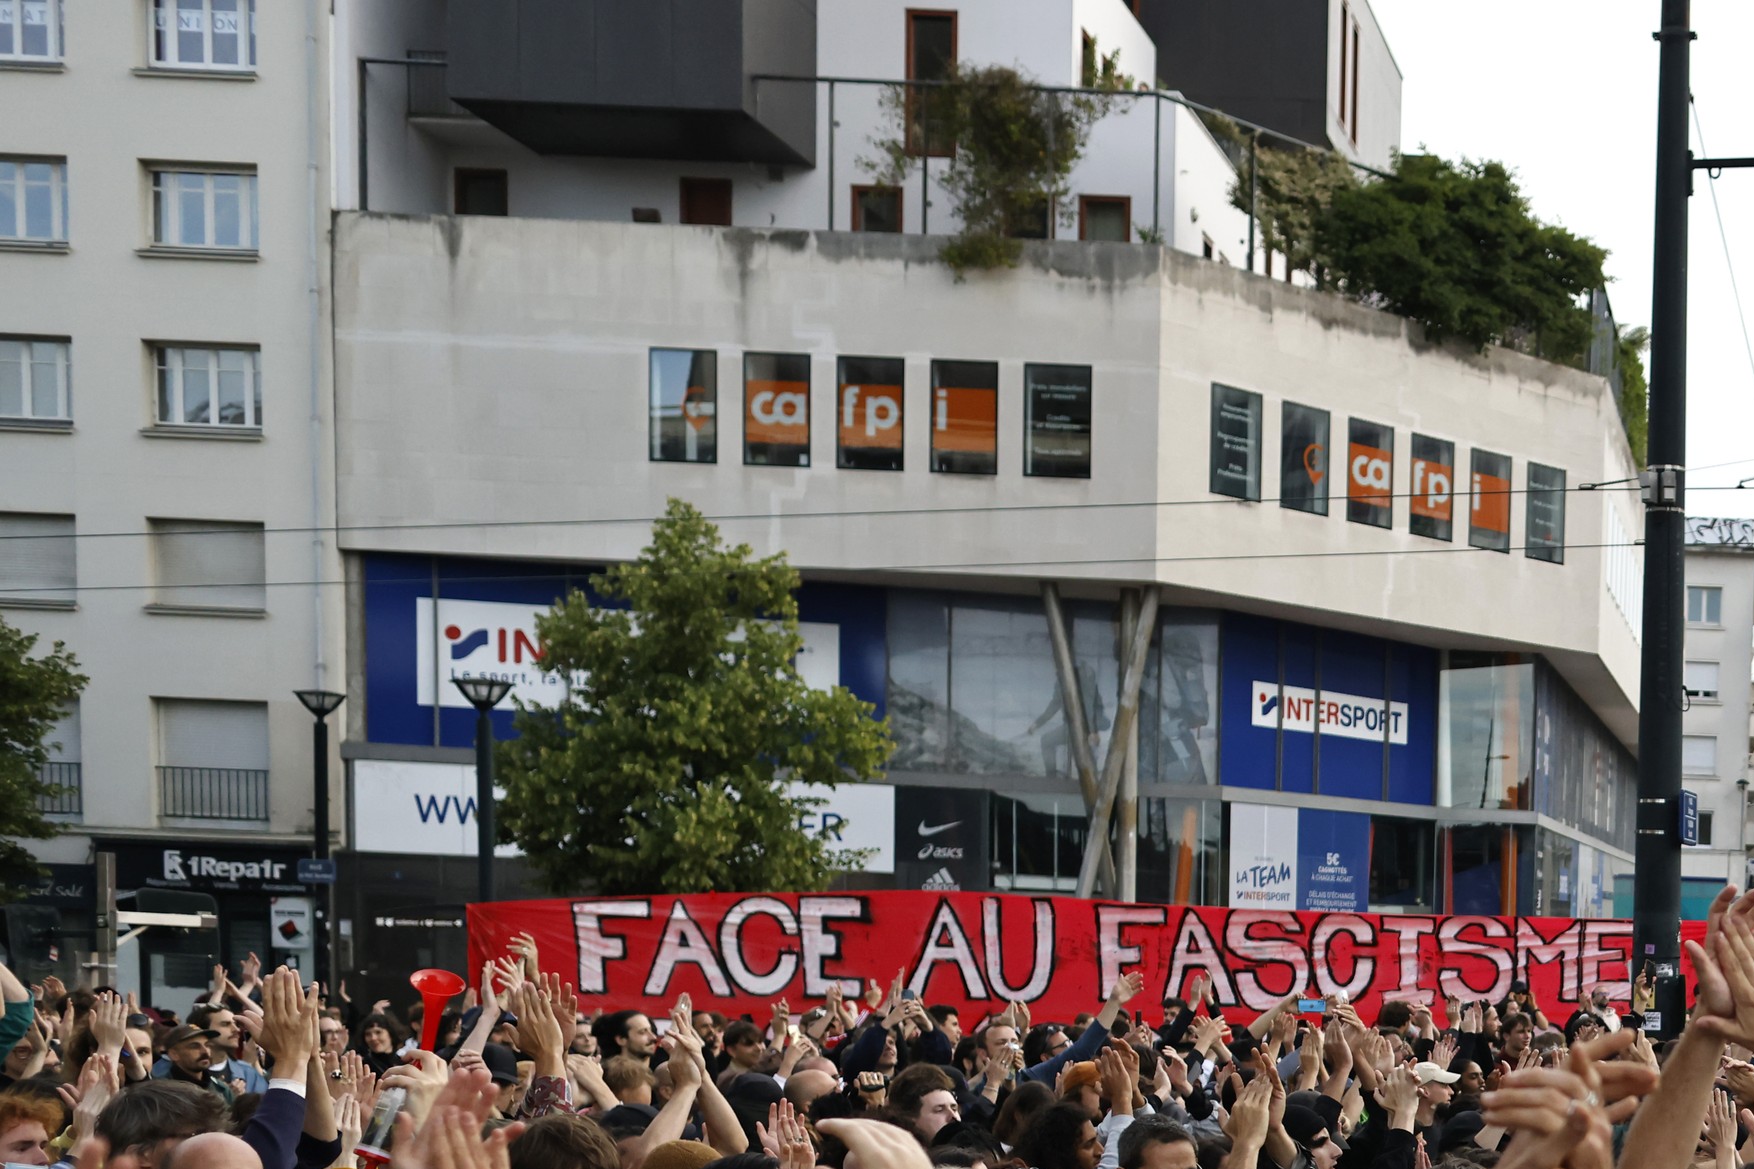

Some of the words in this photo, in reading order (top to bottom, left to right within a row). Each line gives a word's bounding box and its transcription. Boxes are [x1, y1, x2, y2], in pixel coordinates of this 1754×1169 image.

[188, 856, 287, 881] iRepair
[1326, 852, 1340, 866] 5€
[1236, 871, 1248, 884] LA
[1250, 862, 1291, 888] TEAM
[922, 883, 961, 892] adidas
[1244, 890, 1291, 902] INTERSPORT
[572, 896, 871, 999] FACE
[905, 896, 1055, 1003] AU
[1095, 904, 1634, 1013] FASCISME
